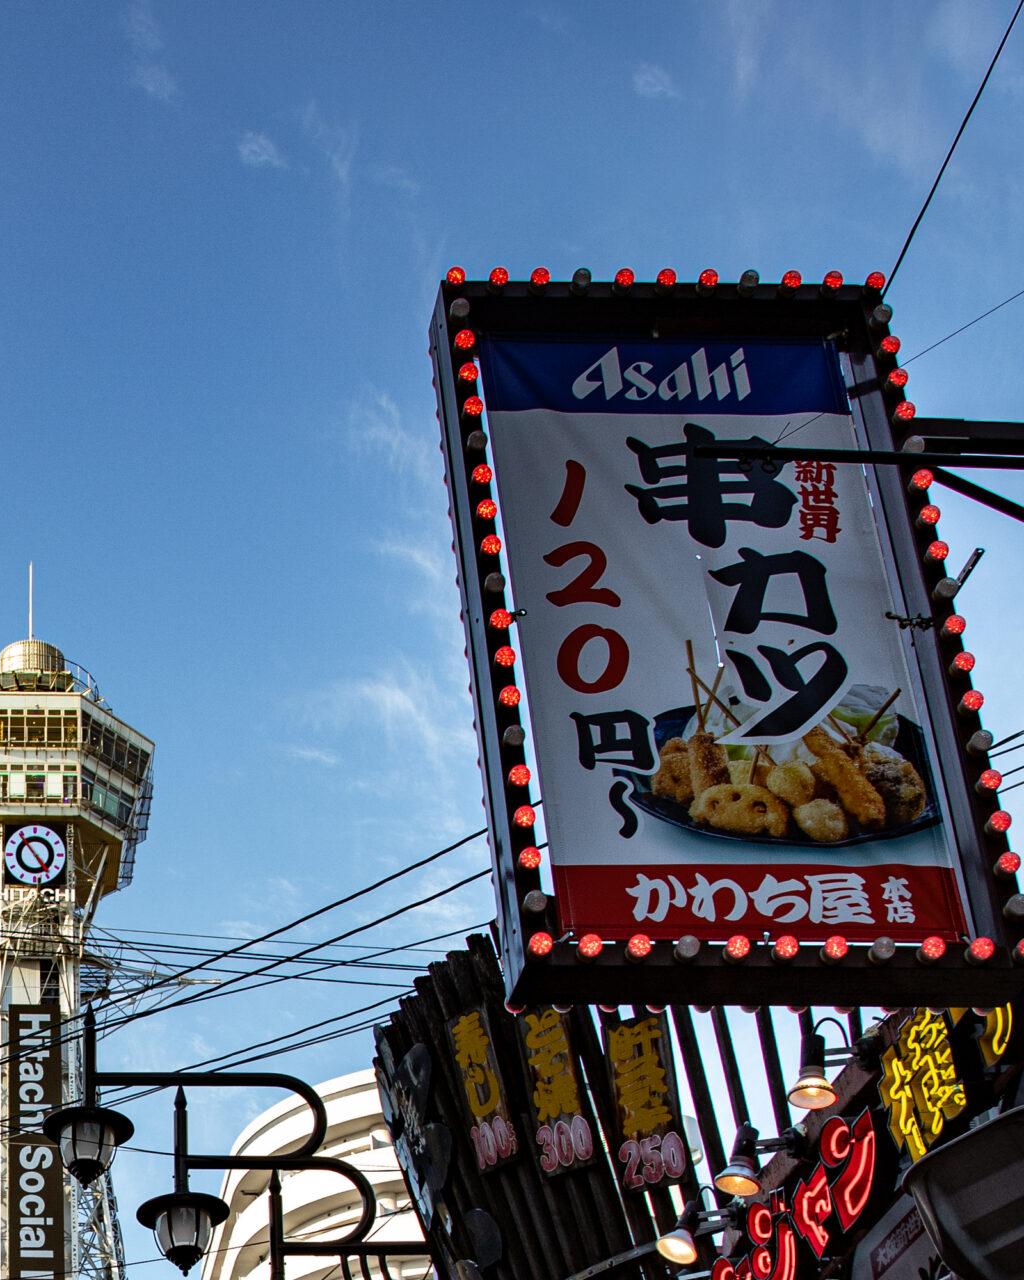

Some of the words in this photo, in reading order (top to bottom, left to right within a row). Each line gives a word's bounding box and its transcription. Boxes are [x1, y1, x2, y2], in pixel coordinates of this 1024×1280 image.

[571, 345, 753, 403] Asahi
[792, 457, 843, 544] 新世界
[624, 422, 849, 740] 串カツ
[625, 872, 877, 926] かわち屋
[880, 875, 917, 925] 本店
[535, 1114, 593, 1173] 300
[618, 1131, 686, 1189] 250
[18, 1145, 54, 1259] Social
